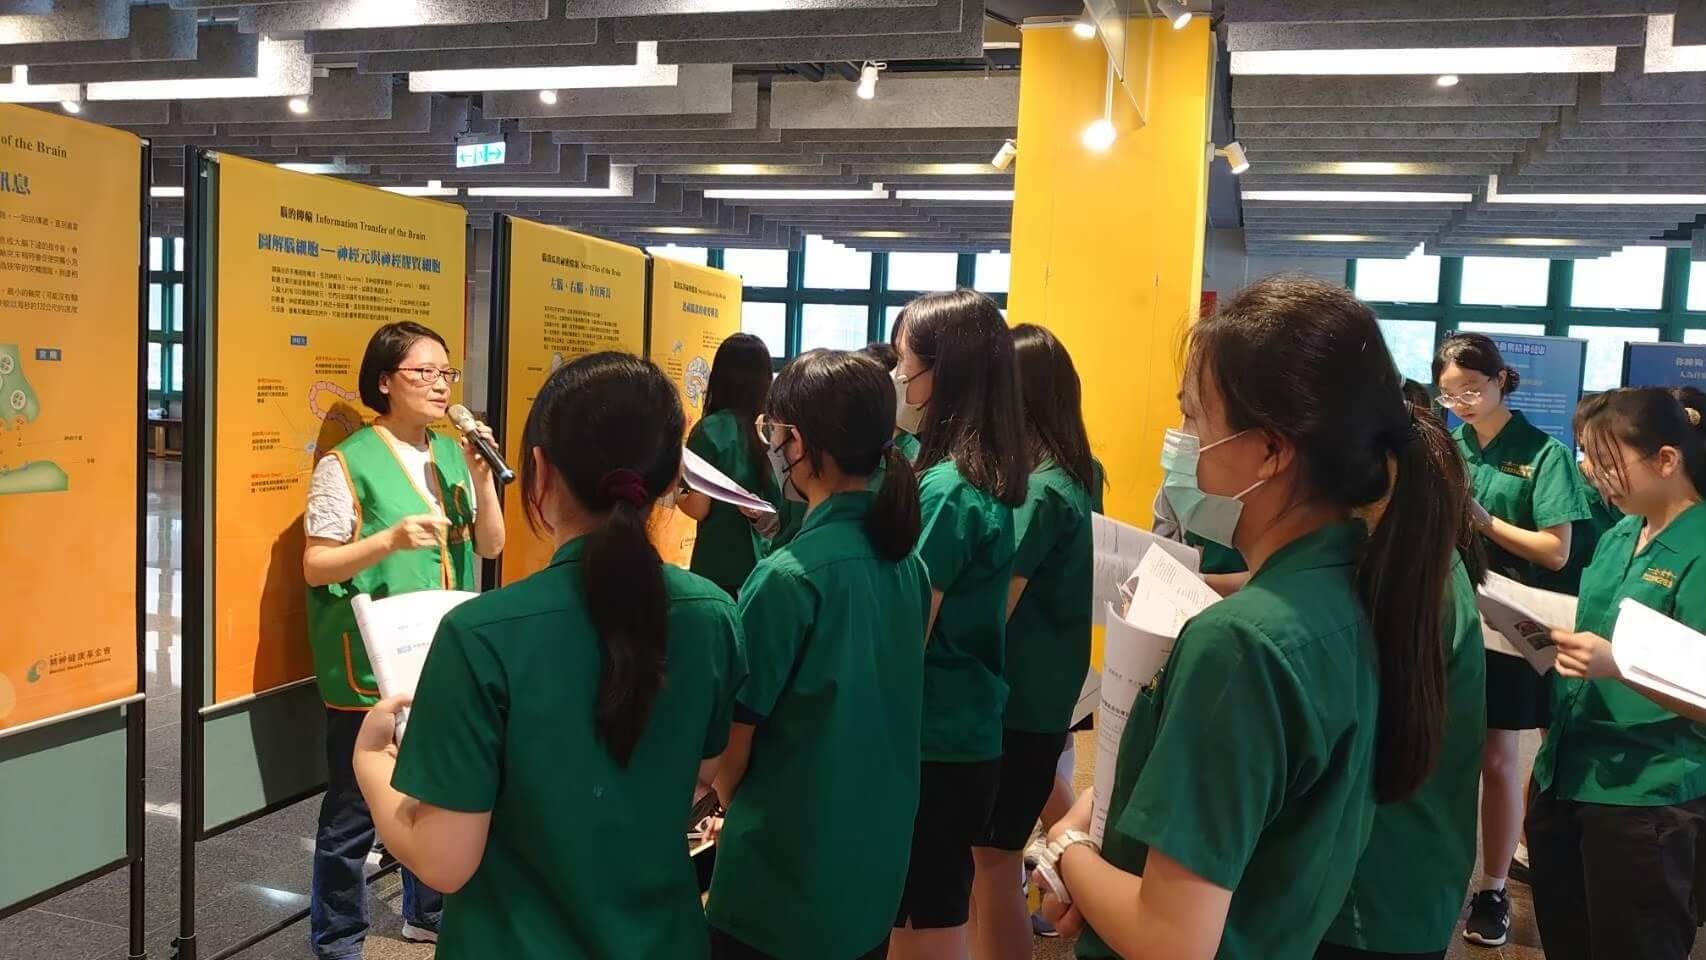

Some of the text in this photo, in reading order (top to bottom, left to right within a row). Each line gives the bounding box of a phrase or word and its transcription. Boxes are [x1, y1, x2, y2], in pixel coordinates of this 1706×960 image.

[1, 135, 67, 159] of the Brain
[316, 213, 358, 230] Information
[360, 221, 387, 236] Transfer
[388, 226, 396, 236] of
[396, 227, 406, 239] the
[408, 230, 426, 241] Brain
